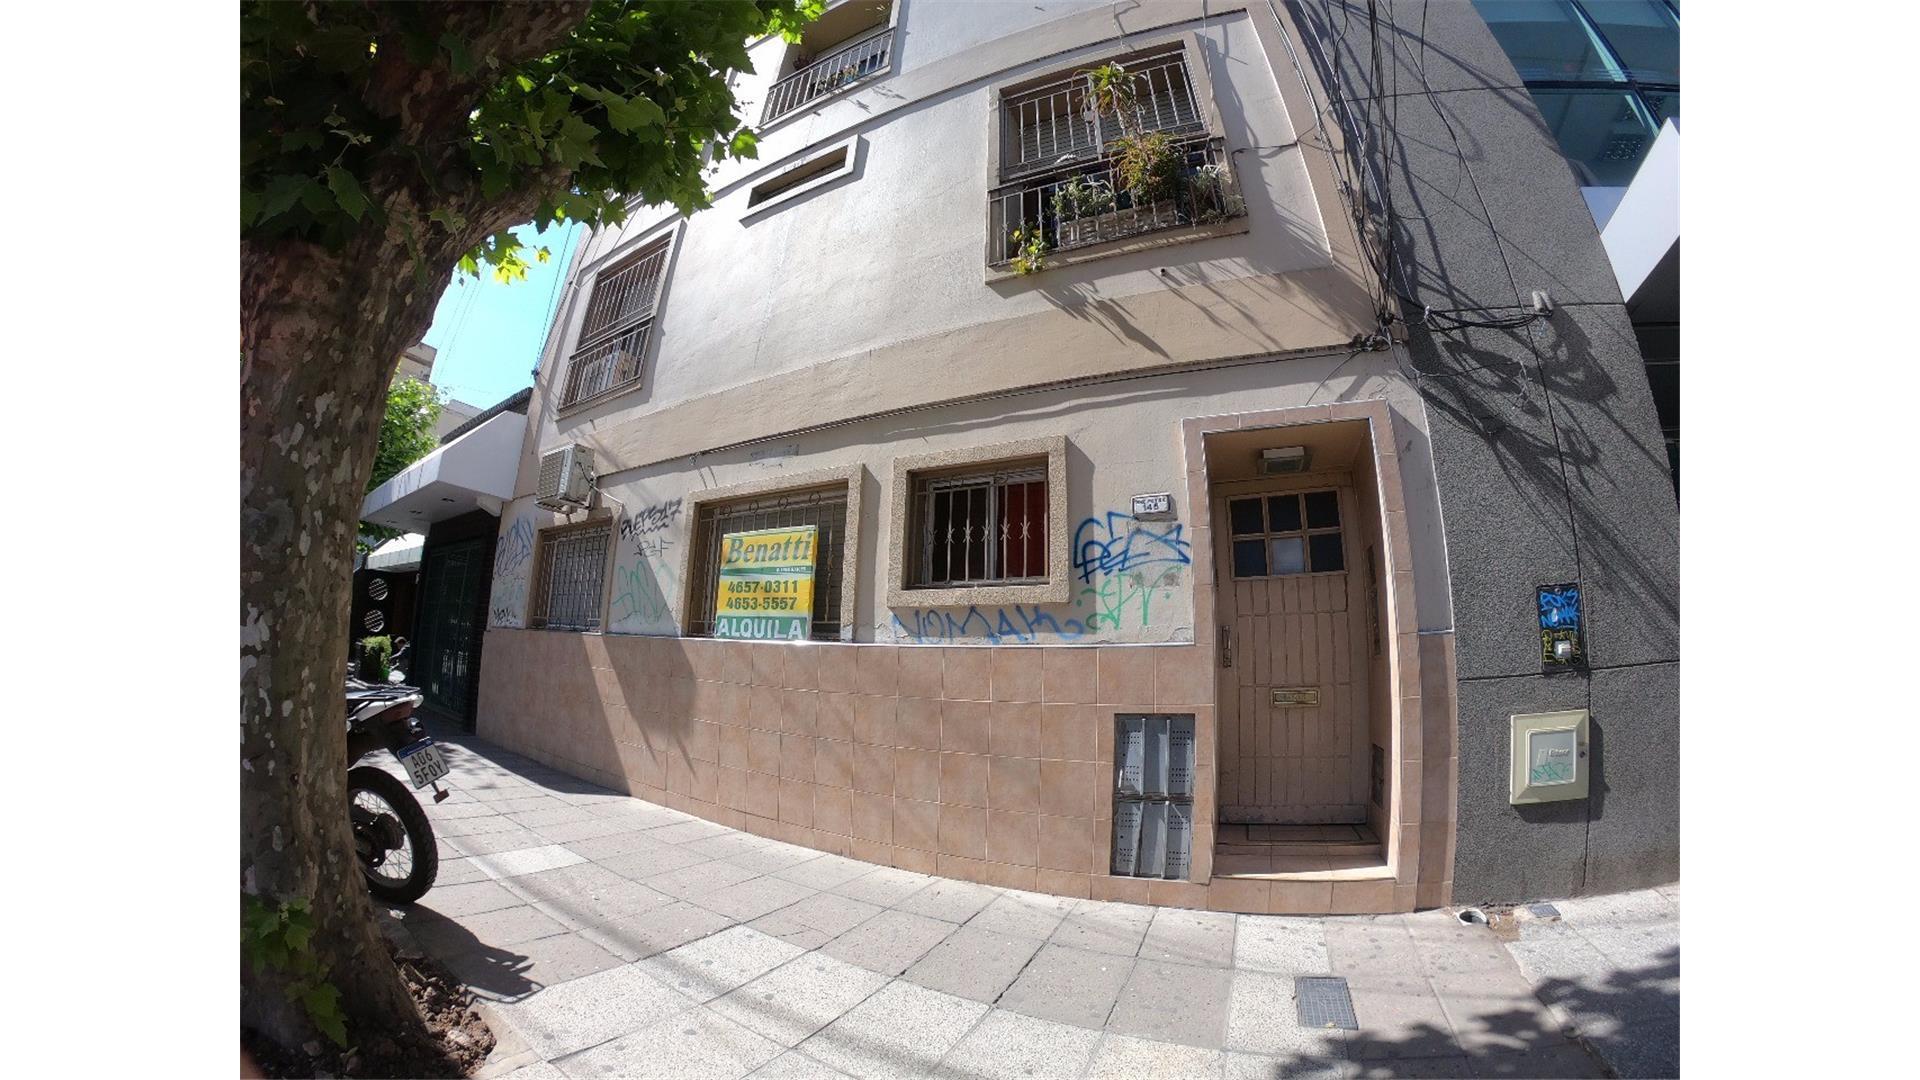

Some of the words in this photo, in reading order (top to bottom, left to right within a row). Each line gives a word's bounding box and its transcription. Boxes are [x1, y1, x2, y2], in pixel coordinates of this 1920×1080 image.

[725, 532, 812, 564] Benatti
[728, 580, 798, 593] 4657-0311
[726, 597, 797, 610] 4653-5557
[717, 617, 804, 639] ALQUILA
